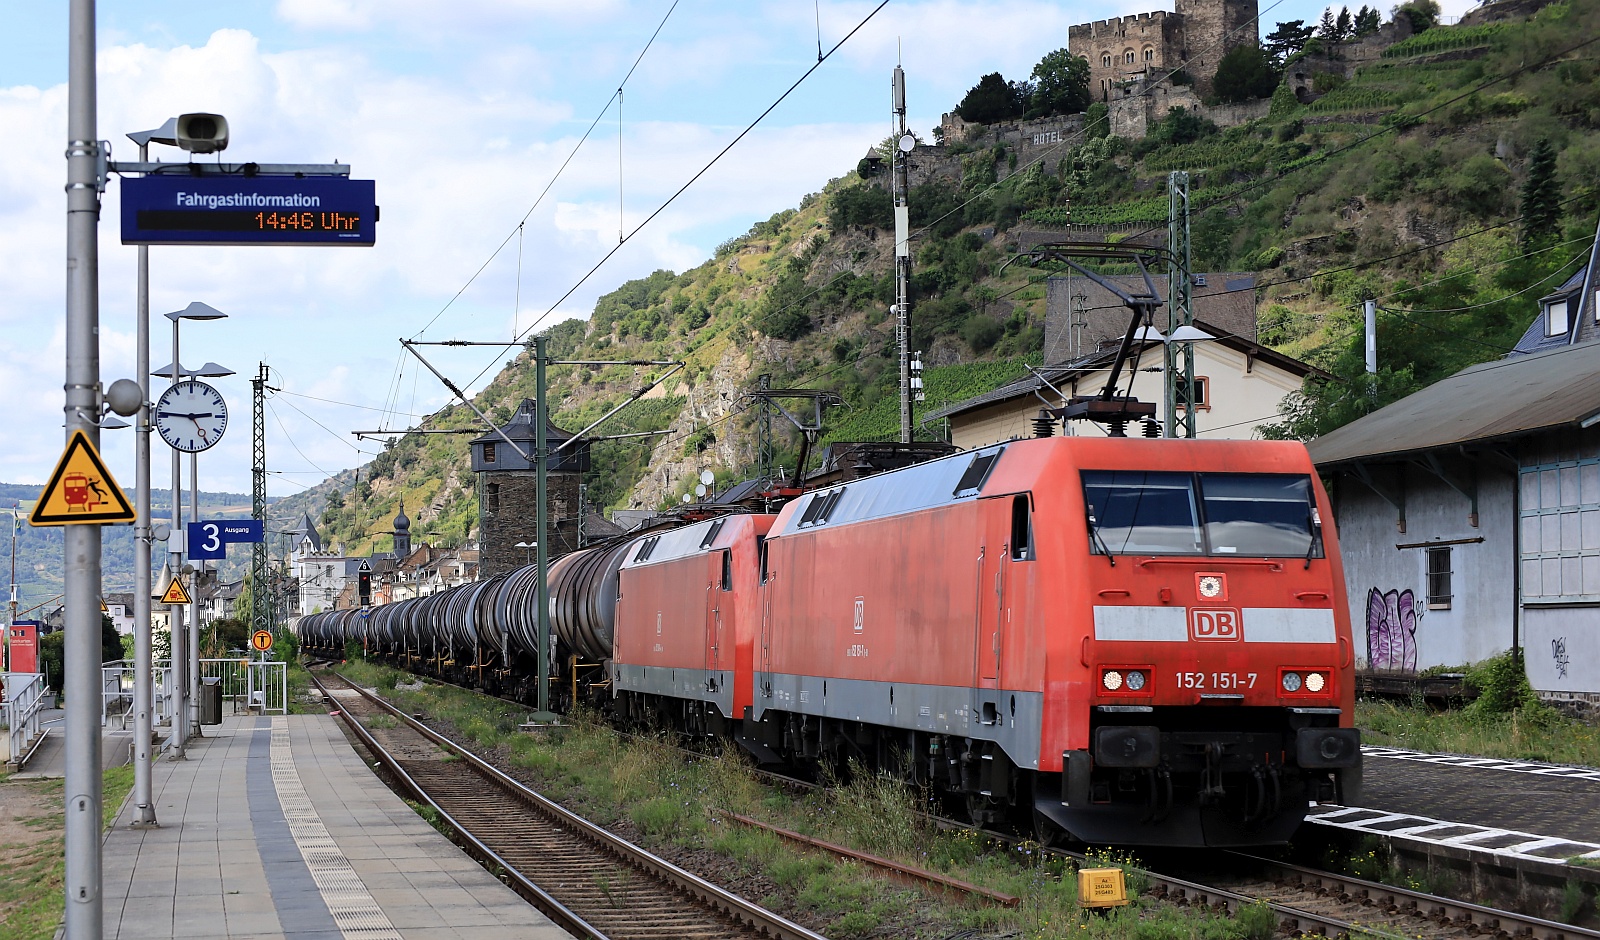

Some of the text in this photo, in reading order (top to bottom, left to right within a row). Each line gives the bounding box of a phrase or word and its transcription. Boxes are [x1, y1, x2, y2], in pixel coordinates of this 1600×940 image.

[1033, 130, 1062, 145] HOTEL
[176, 191, 320, 209] Fahrgastinformation
[255, 212, 360, 230] 14:46 Uhr
[201, 523, 220, 552] 3
[362, 562, 367, 570] 6
[1196, 612, 1234, 636] DB
[1175, 672, 1258, 689] 152 151-7
